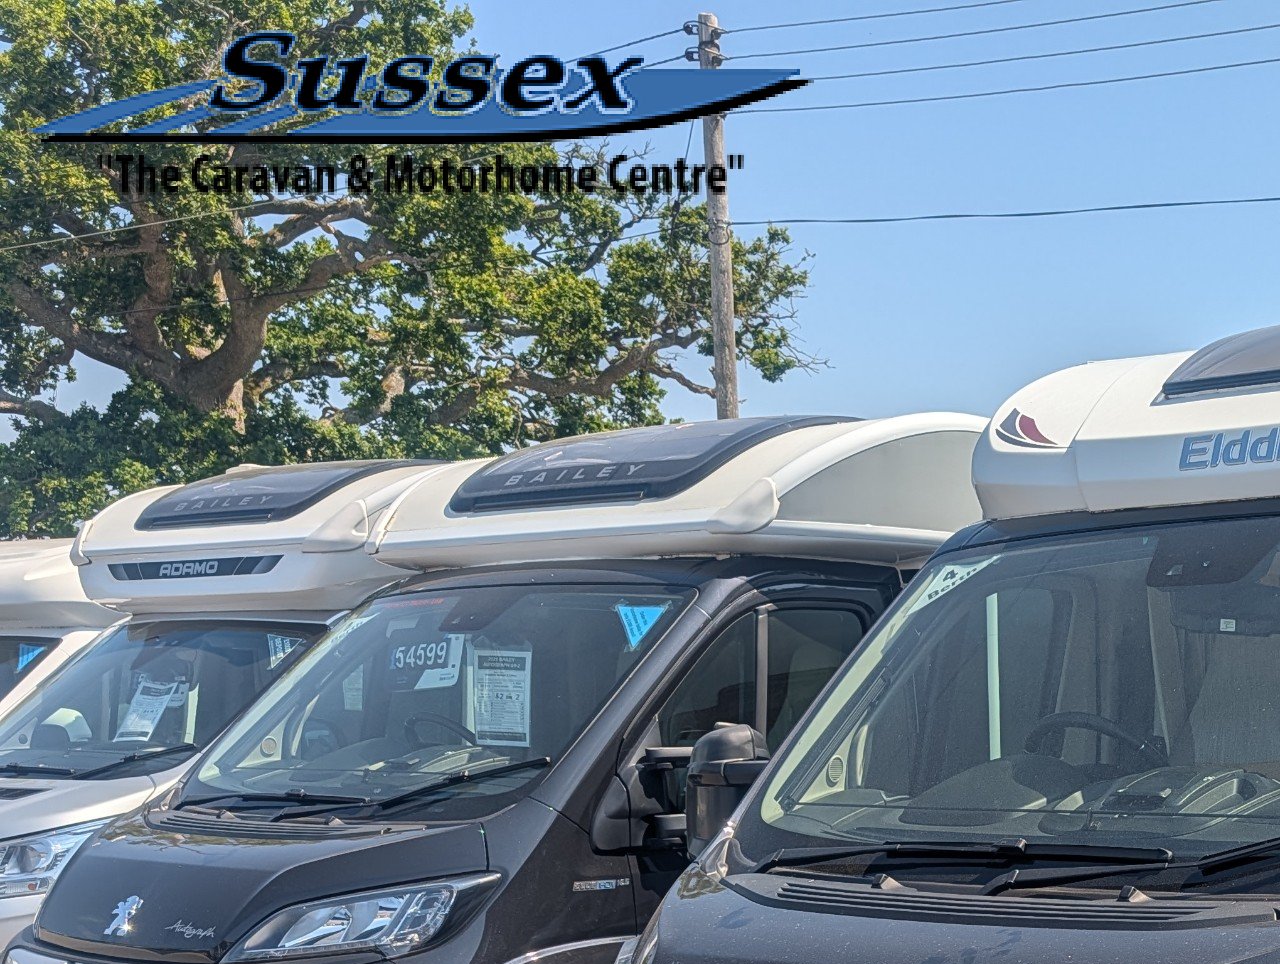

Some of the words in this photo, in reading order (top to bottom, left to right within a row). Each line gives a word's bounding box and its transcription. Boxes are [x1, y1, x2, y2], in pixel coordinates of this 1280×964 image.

[504, 463, 645, 487] BAILEY
[173, 495, 273, 512] BAILEY
[159, 560, 219, 577] ADAMO
[942, 569, 959, 582] 4
[927, 567, 978, 601] Berth
[164, 919, 217, 939] Autograph
